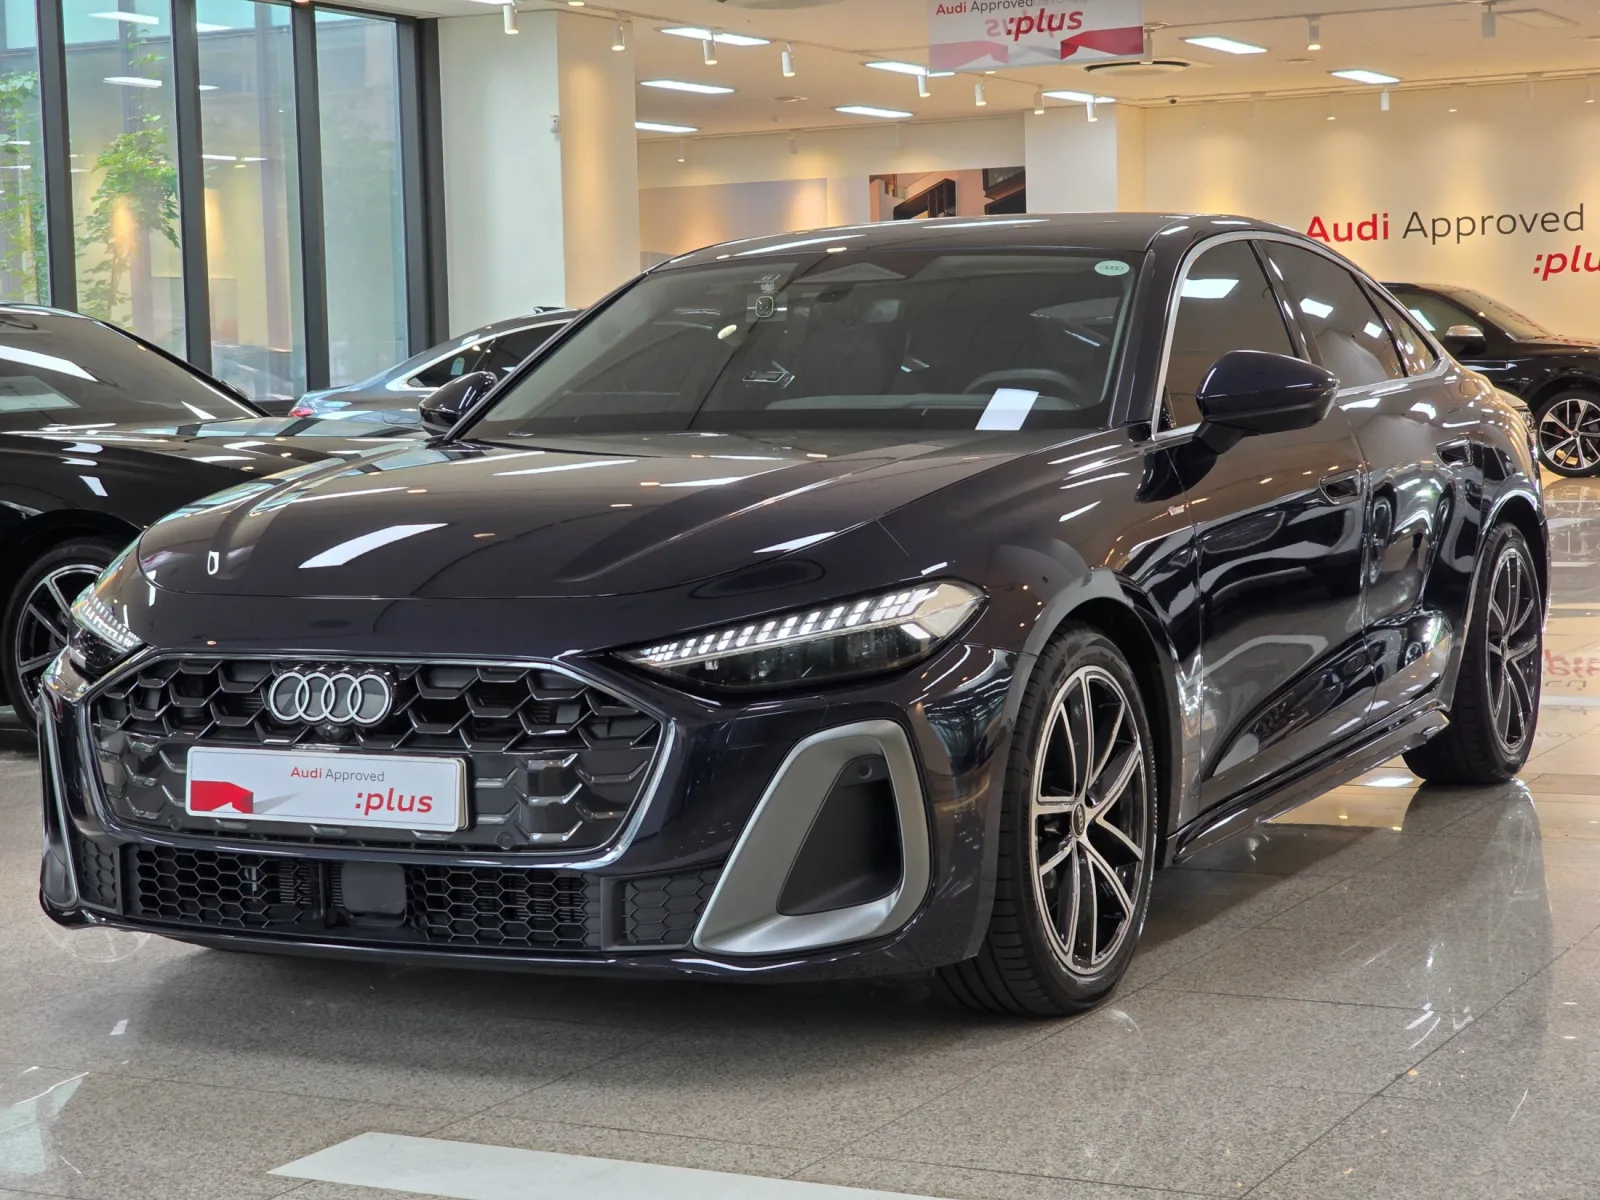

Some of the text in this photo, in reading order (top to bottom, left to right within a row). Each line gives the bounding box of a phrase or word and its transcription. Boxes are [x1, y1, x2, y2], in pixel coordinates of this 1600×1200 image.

[936, 2, 967, 15] Audi
[971, 0, 1033, 14] Approved
[1006, 8, 1083, 41] :plus
[1306, 203, 1584, 245] Audi Approved
[291, 767, 384, 782] Audi Approved
[355, 788, 433, 815] :plus
